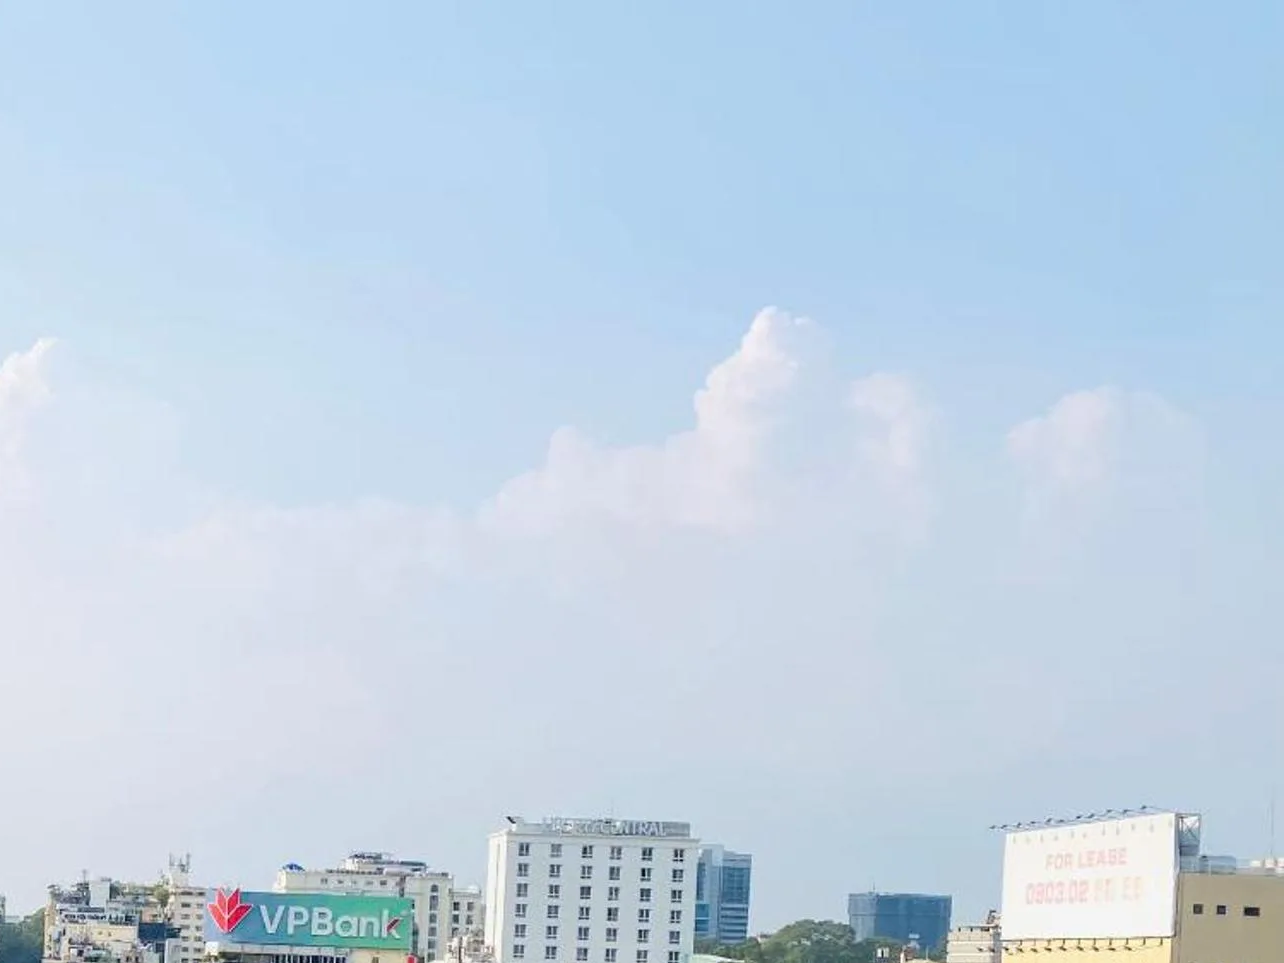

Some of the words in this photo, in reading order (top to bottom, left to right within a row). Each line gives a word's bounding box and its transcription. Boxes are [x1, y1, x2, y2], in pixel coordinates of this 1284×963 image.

[1045, 852, 1073, 870] FOR
[1078, 847, 1127, 869] LEASE
[260, 904, 405, 939] VPBank
